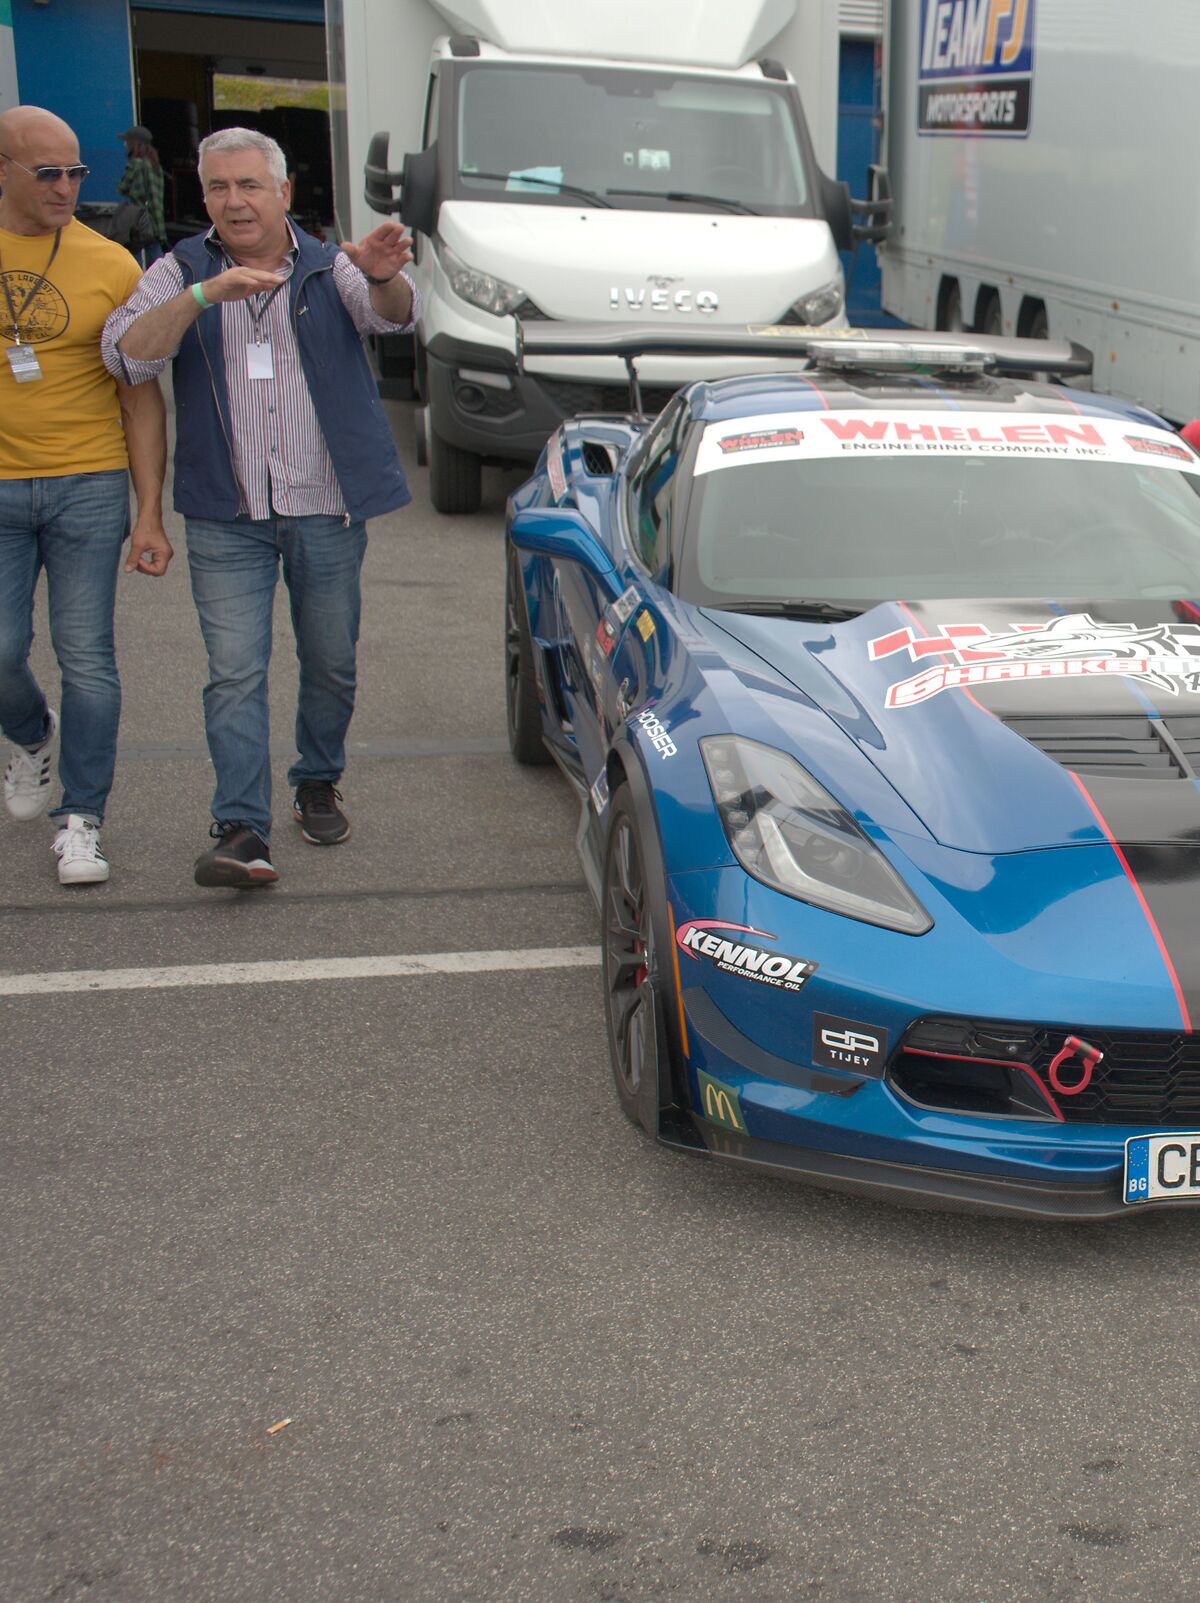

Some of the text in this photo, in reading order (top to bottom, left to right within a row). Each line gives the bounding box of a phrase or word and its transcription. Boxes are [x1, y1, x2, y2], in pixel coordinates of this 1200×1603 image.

[926, 90, 1018, 123] MOTORSPORTS
[609, 287, 720, 313] IVECO
[820, 418, 1106, 446] WHELEN
[841, 443, 1112, 456] ENGINEERING COMPANY INC.
[636, 707, 678, 760] HOOSIER
[682, 926, 808, 984] KENNOL
[717, 961, 800, 991] PERFORMANCE OIL
[829, 1049, 870, 1067] TIJEY
[1129, 1176, 1147, 1193] BG
